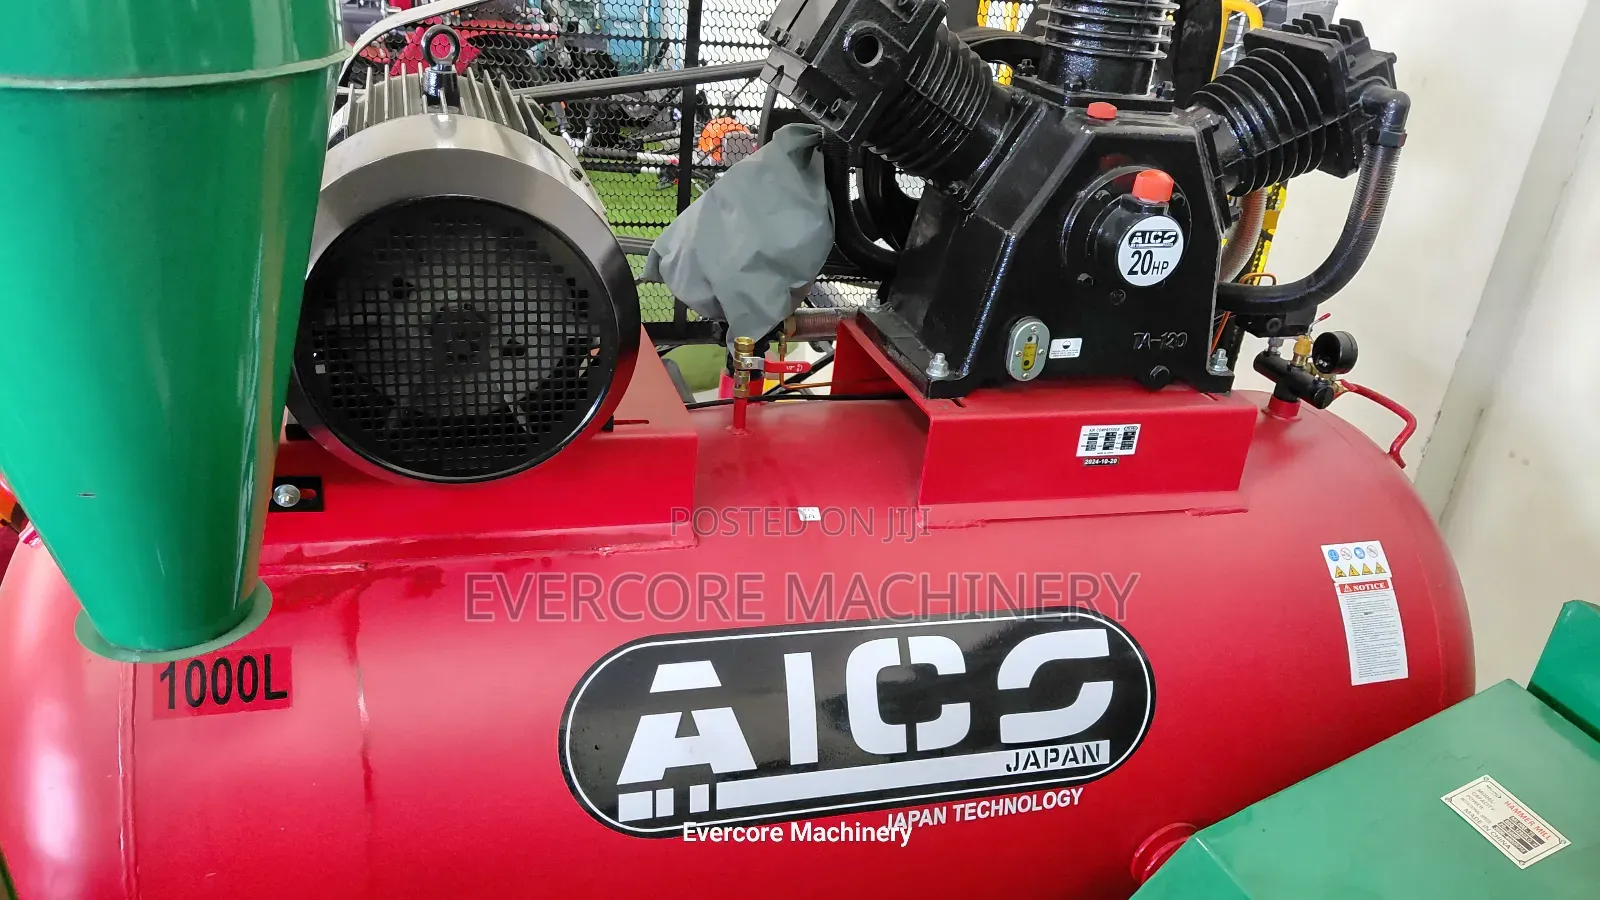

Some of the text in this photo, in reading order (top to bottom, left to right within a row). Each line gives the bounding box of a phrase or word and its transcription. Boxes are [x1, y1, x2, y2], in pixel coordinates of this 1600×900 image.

[1131, 231, 1177, 244] AICS
[1352, 582, 1386, 592] NOTICE
[160, 653, 288, 710] 1000L
[616, 628, 1114, 786] AICS
[1005, 742, 1103, 773] JAPAN
[885, 787, 1084, 832] JAPAN TECHNOLOGY
[1463, 807, 1485, 828] MADE
[1482, 824, 1491, 832] IN
[1490, 831, 1512, 850] CHINA
[1503, 800, 1536, 827] HAMMER
[1533, 825, 1552, 841] MILL
